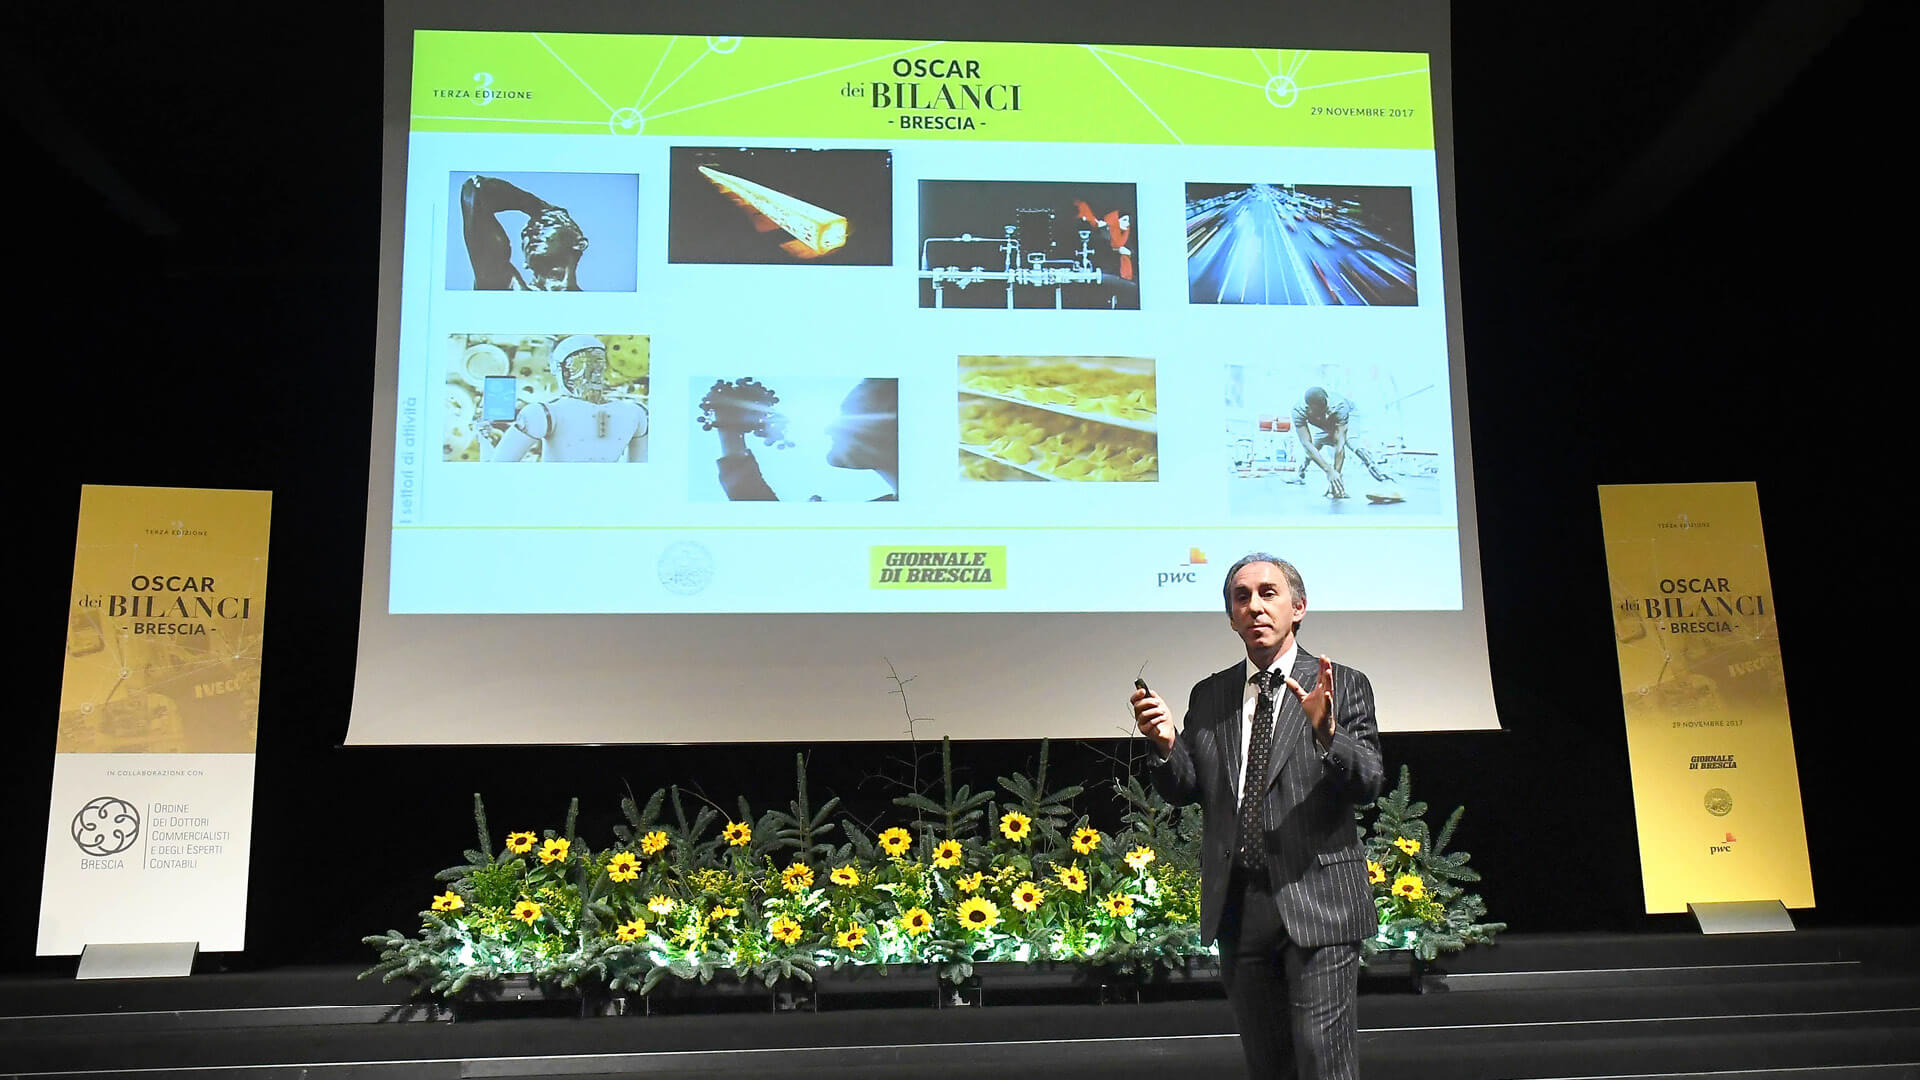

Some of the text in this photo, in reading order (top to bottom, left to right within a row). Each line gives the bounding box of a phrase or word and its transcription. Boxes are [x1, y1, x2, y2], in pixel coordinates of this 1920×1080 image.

[893, 59, 980, 79] OSCAR
[433, 89, 533, 100] TERZA EDIZIONE
[841, 82, 1022, 111] dei BILANCI
[1311, 107, 1414, 118] 29 NOVEMBRE 2017
[900, 116, 975, 130] BRESCIA
[172, 529, 208, 537] EDIZIONE
[886, 552, 987, 567] GIORNALE
[879, 569, 992, 583] DI BRESCIA
[1157, 572, 1197, 587] pwc
[131, 575, 214, 592] OSCAR
[1660, 578, 1730, 593] OSCAR
[78, 594, 252, 620] dei BILANCI
[1620, 596, 1765, 619] dei BILANCI
[134, 623, 206, 635] BRESCIA
[1671, 622, 1732, 633] BRESCIA
[1683, 720, 1724, 728] NOVEMBRE
[1691, 755, 1734, 763] GIORNALE
[1700, 761, 1737, 770] BRESCIA
[159, 846, 183, 855] DEGLI
[1710, 846, 1731, 855] pwc
[81, 859, 124, 870] BRESCIA
